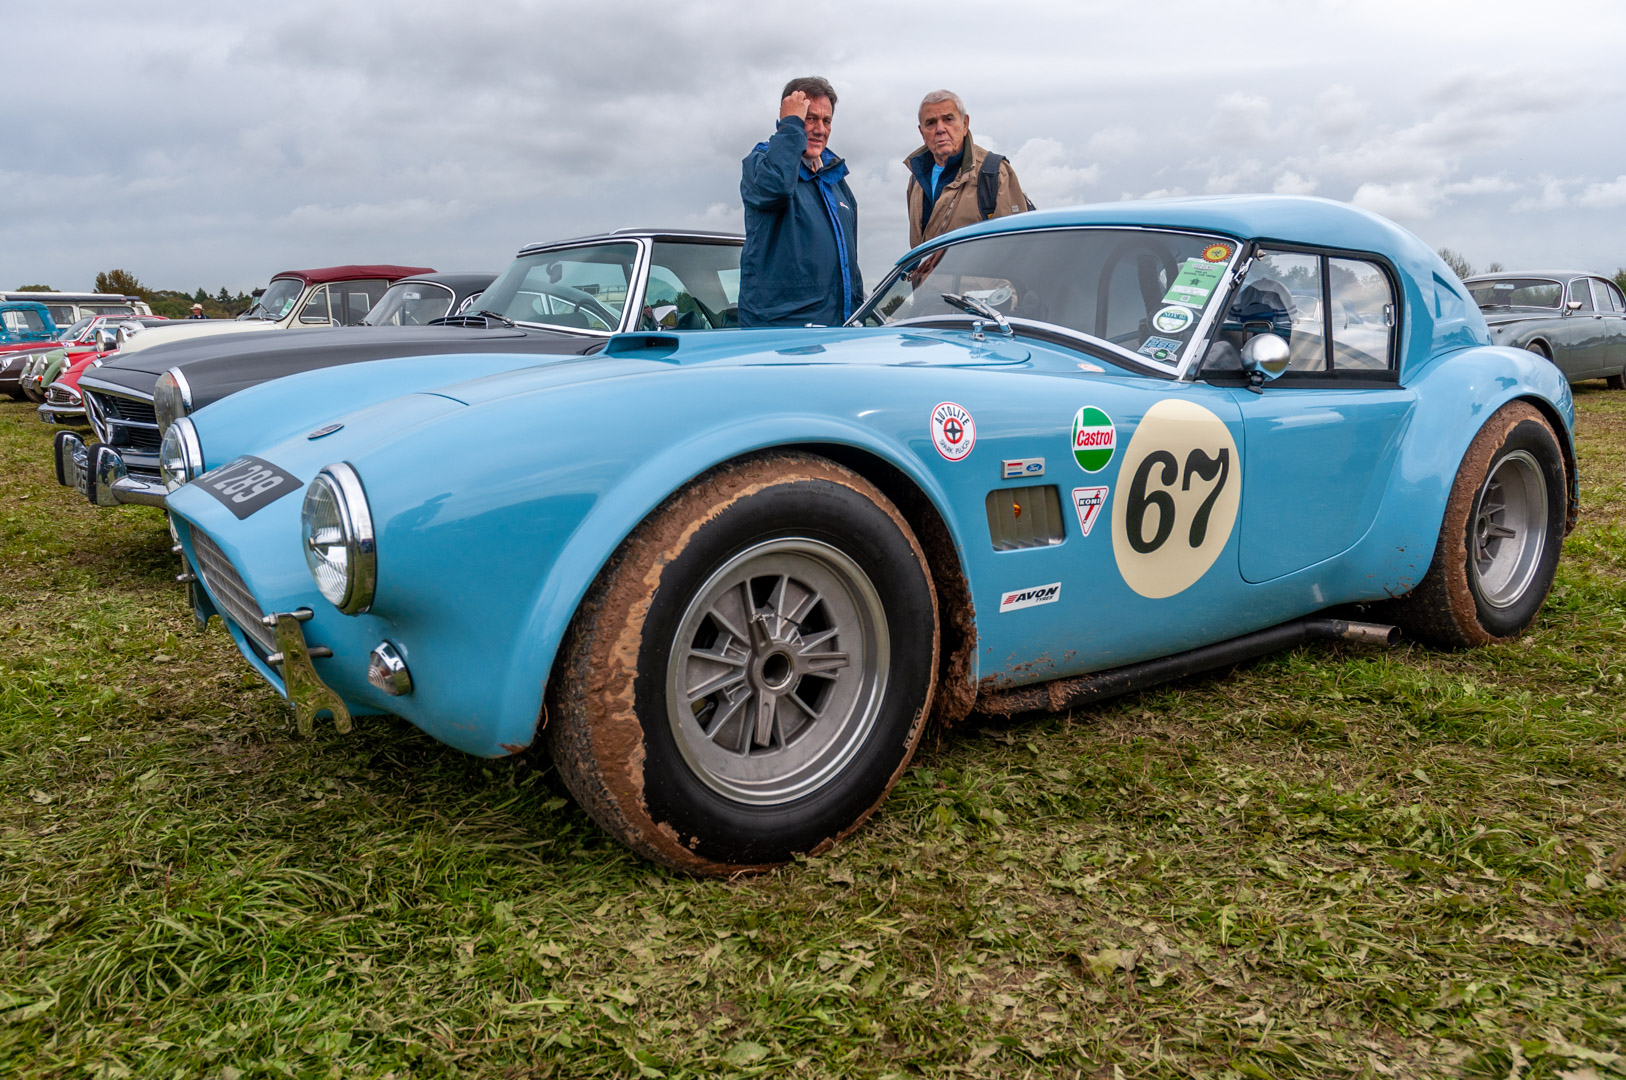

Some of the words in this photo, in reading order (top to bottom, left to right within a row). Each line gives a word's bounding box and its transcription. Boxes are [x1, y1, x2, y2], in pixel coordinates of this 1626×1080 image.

[935, 406, 970, 426] AUTOLITE
[940, 439, 953, 454] SPARK
[955, 439, 970, 454] PLUGS
[1076, 429, 1114, 447] Castrol
[212, 464, 285, 503] 289
[1080, 498, 1100, 506] KONI
[1126, 447, 1230, 554] 67
[1015, 586, 1059, 603] AVON
